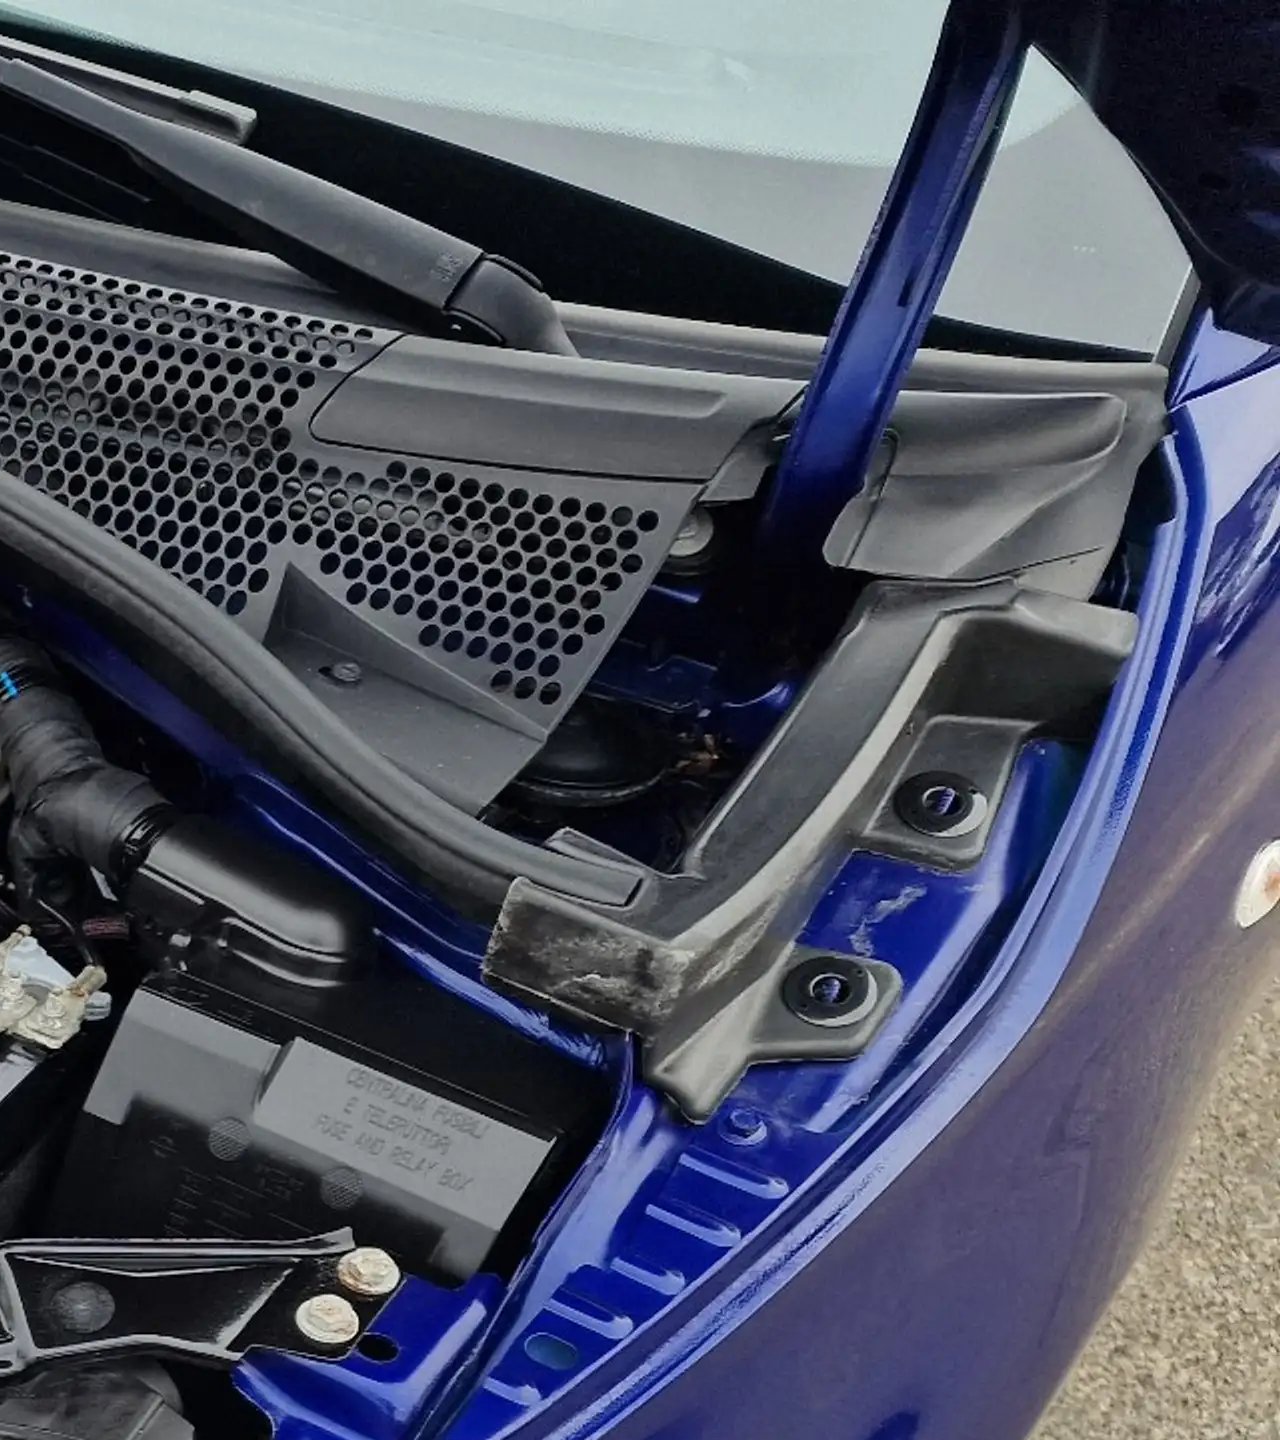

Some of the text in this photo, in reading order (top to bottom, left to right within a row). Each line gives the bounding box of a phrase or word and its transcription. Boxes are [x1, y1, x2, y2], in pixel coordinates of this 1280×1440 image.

[315, 1113, 474, 1192] FUSE AND RELAY BOX
